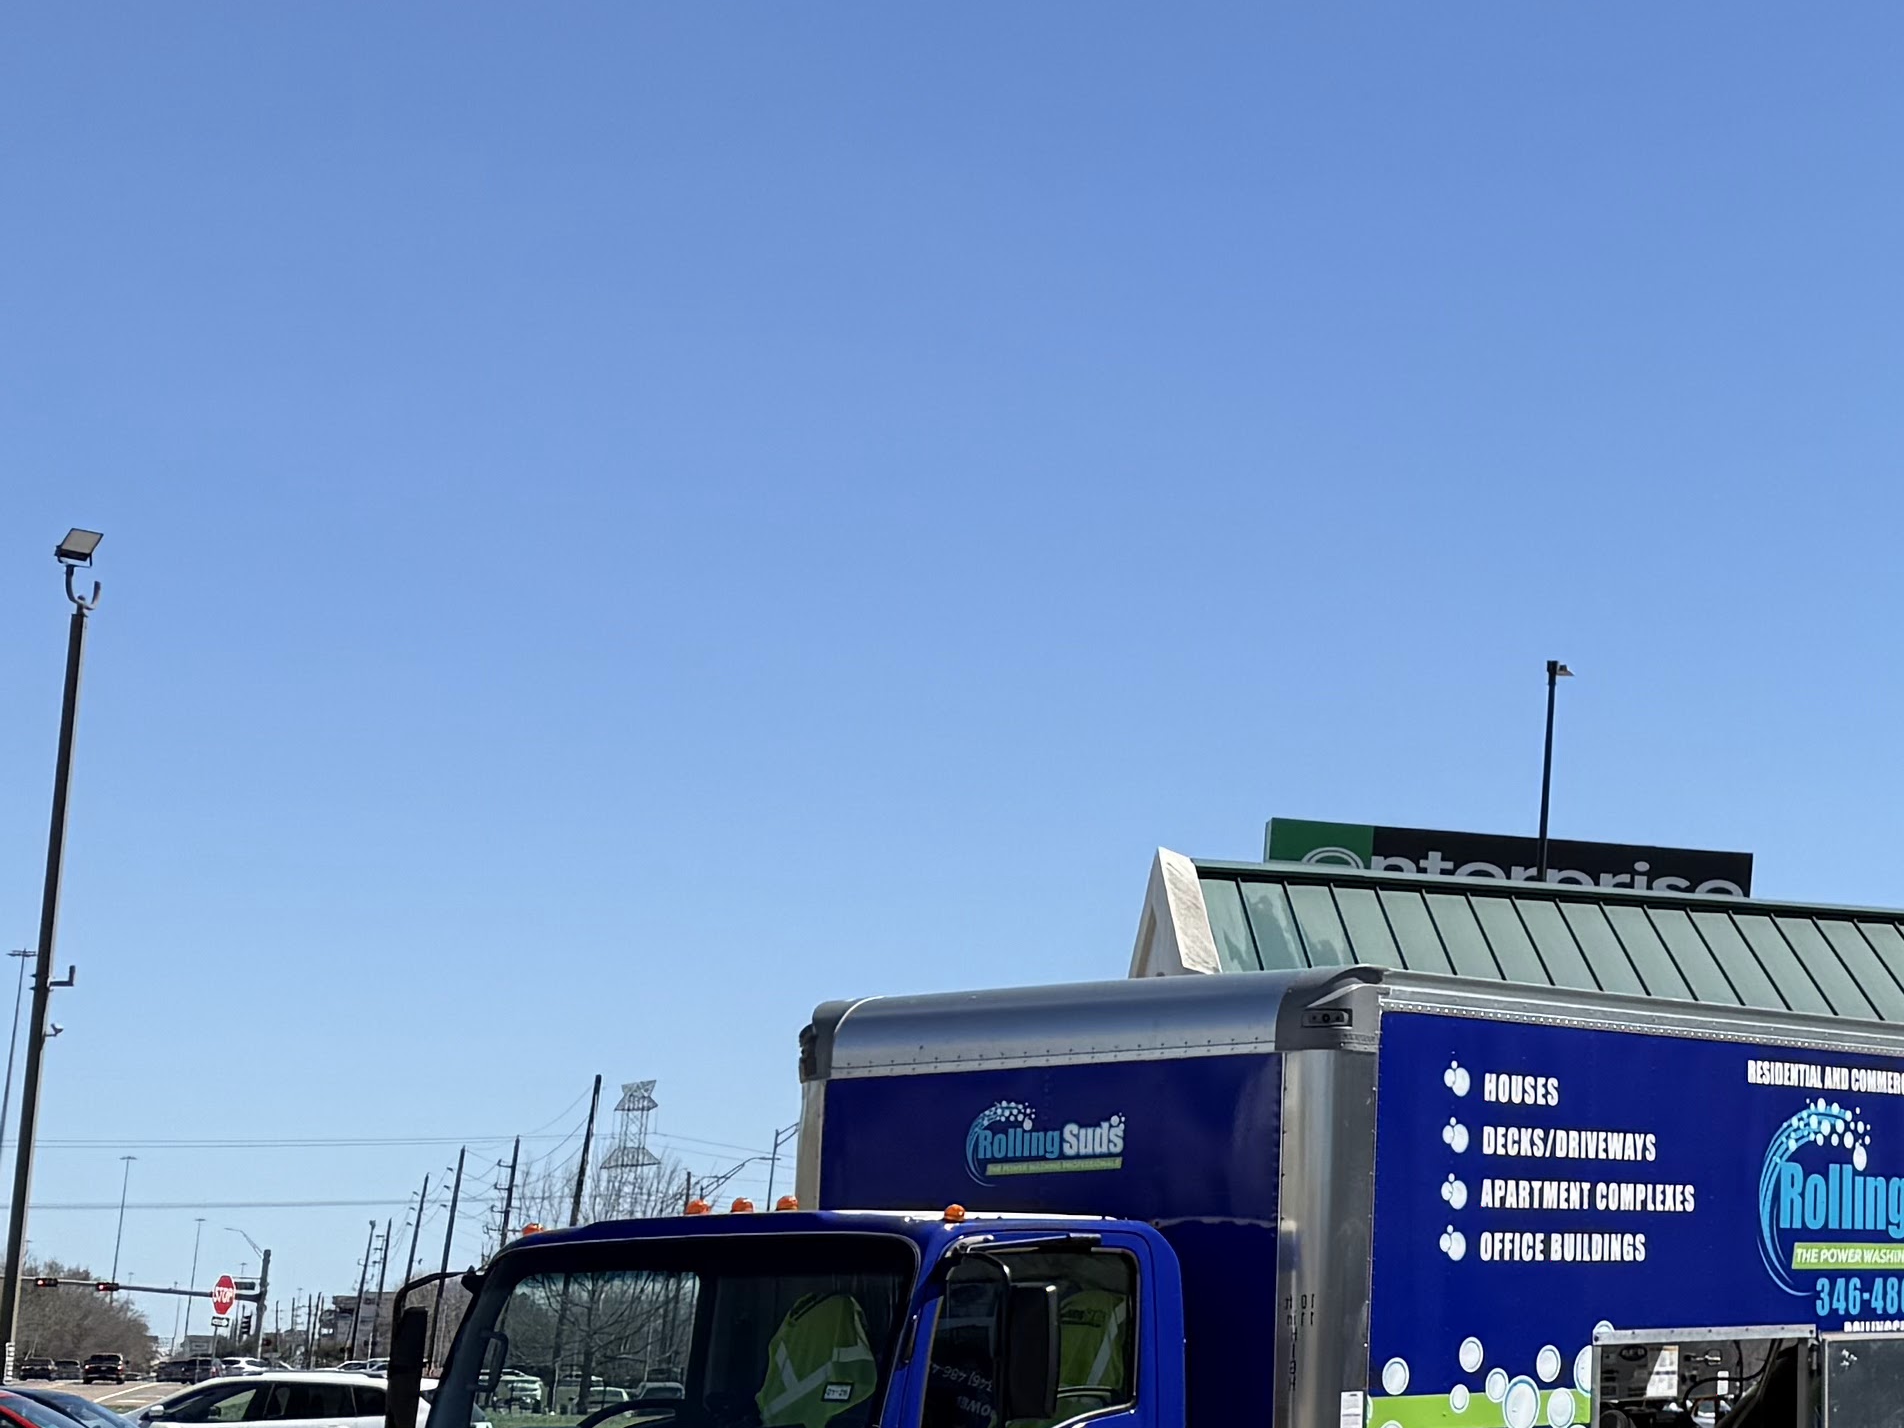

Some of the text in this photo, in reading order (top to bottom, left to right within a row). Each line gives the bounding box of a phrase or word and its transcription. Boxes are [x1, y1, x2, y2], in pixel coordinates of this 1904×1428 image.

[1484, 1073, 1559, 1106] HOUSES
[1747, 1059, 1822, 1089] RESIDENTIAL
[1824, 1067, 1849, 1090] AND
[978, 1122, 1124, 1159] Rolling Suds
[1482, 1126, 1656, 1161] DECKS/DRIVEWAYS
[1481, 1179, 1695, 1212] APARTMENT COMPLEXES
[1480, 1232, 1646, 1261] OFFICE BUILDINGS
[1796, 1248, 1819, 1263] THE
[1820, 1248, 1862, 1263] POWER
